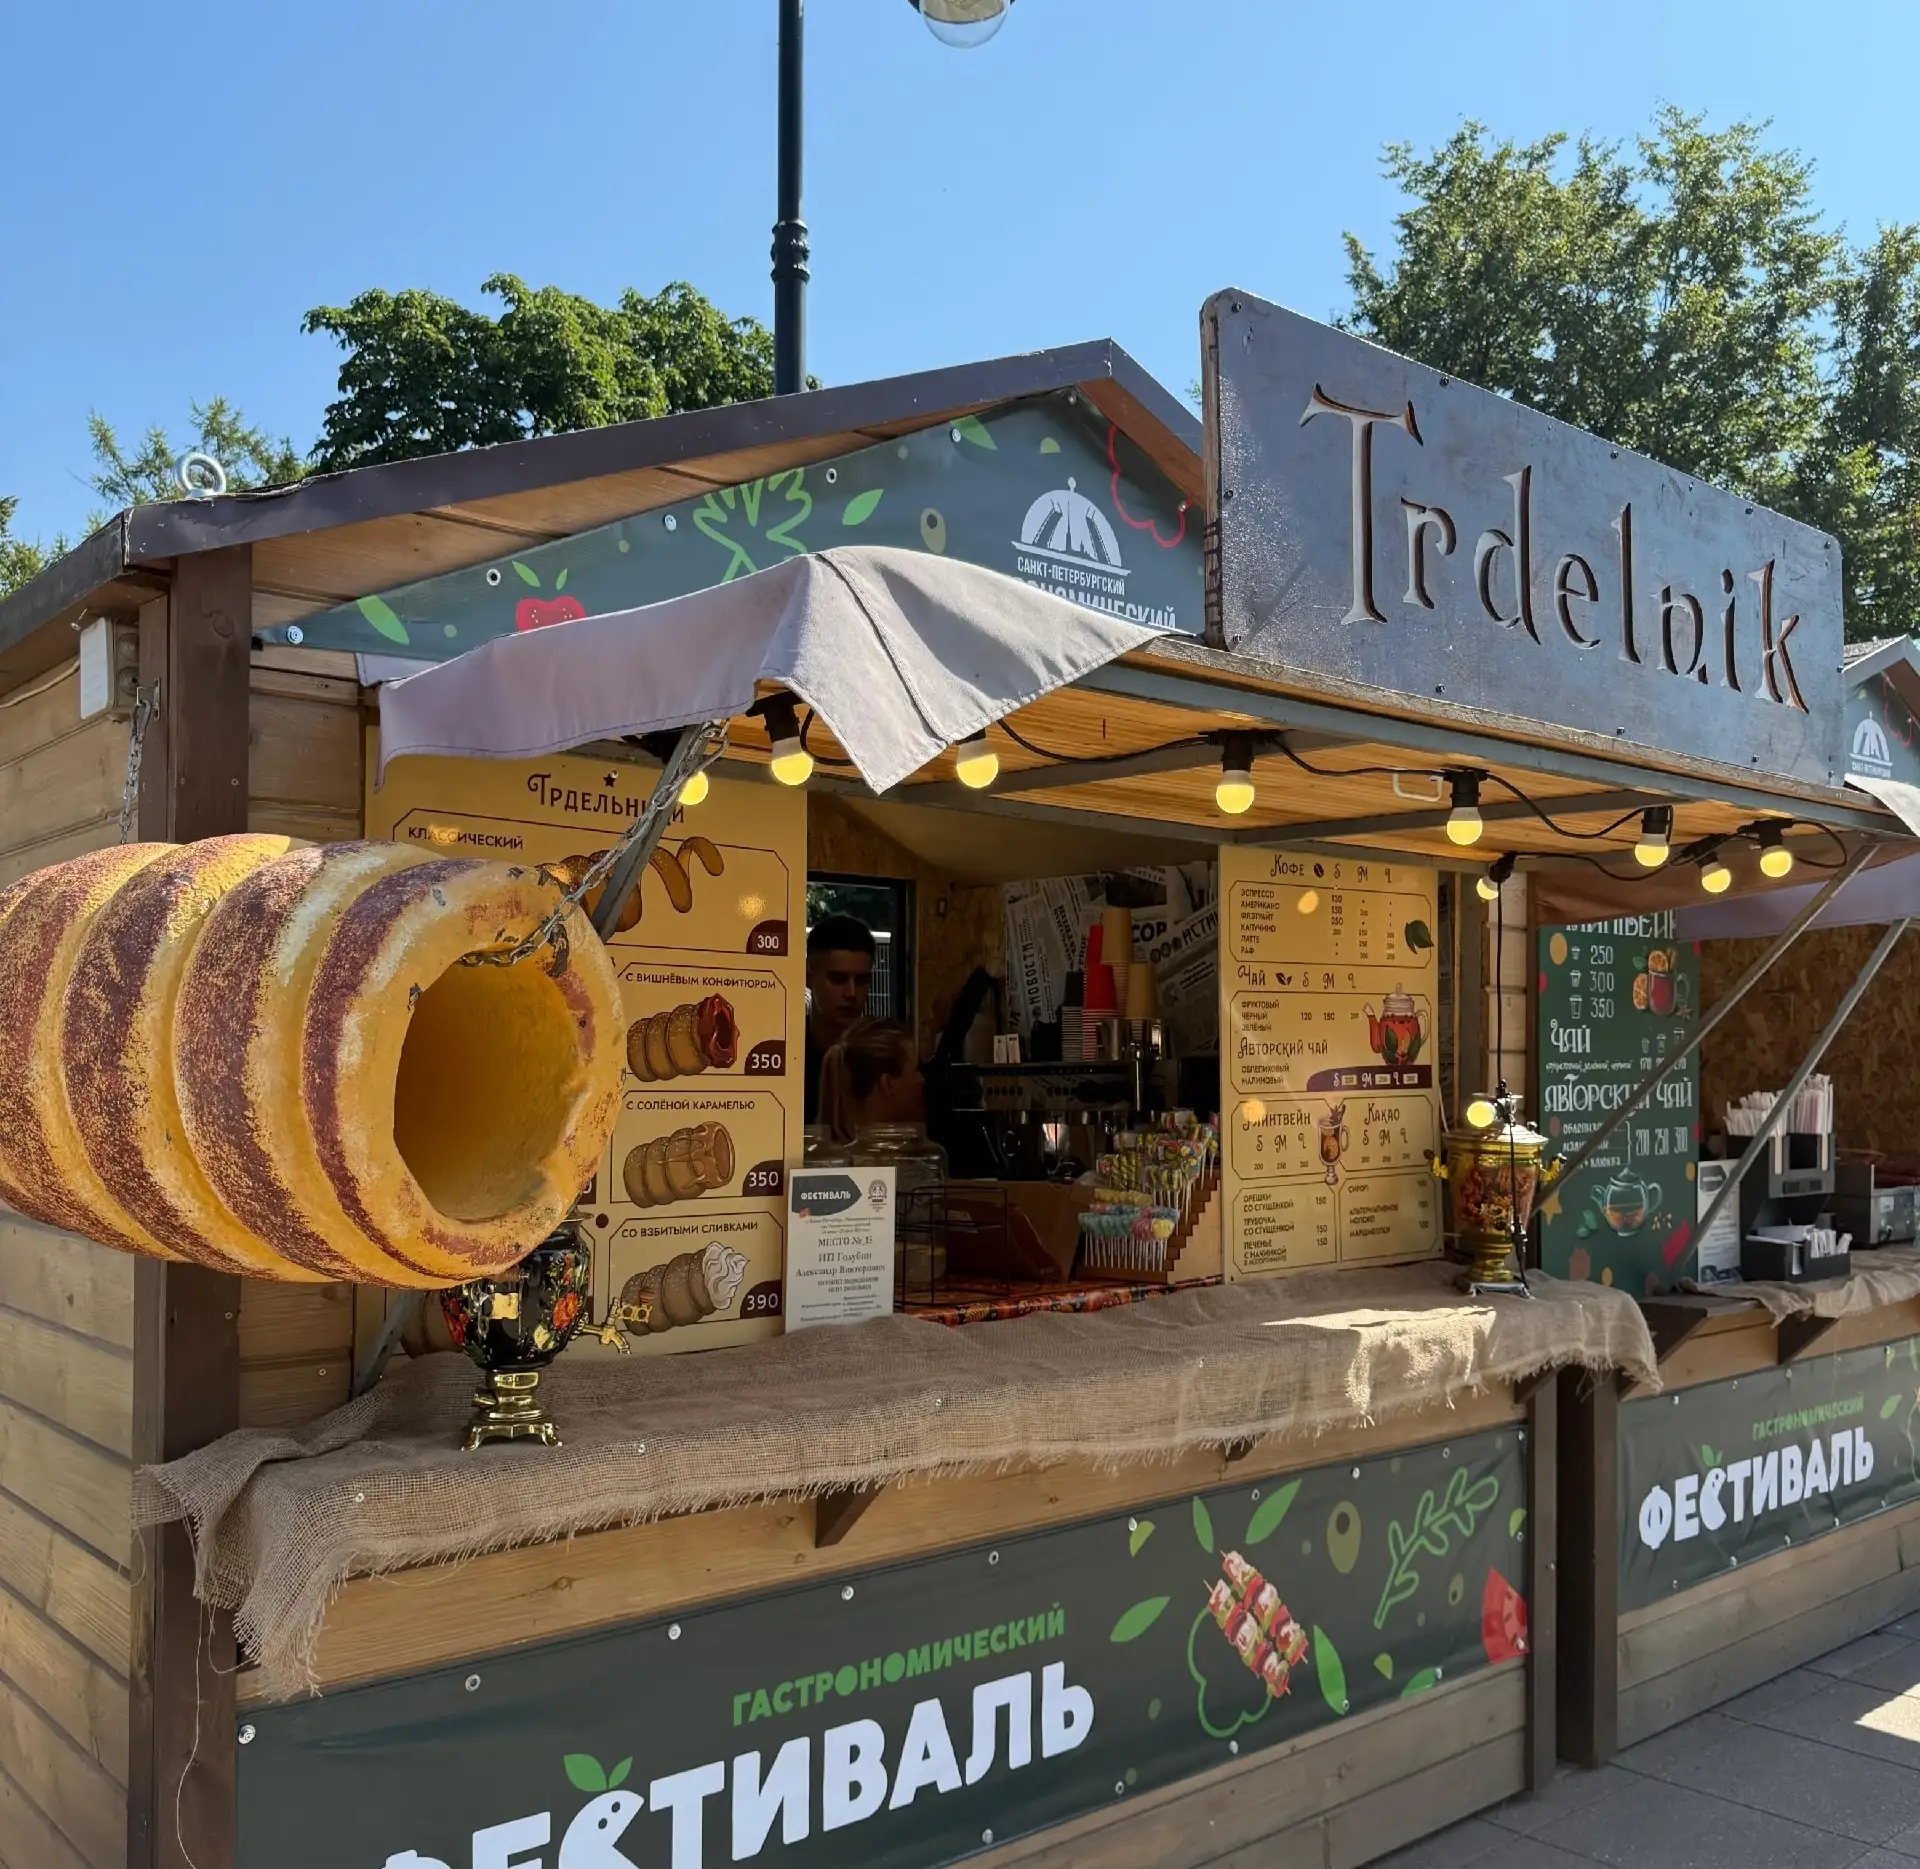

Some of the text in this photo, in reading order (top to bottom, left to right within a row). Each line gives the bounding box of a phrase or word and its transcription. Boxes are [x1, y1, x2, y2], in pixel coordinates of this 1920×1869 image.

[1300, 384, 1809, 713] Trdelnik
[1018, 557, 1125, 596] САНКТ-ПЕТЕРБУРГСКИЙ
[527, 773, 684, 824] ТРДЕЛЬНИ
[408, 826, 523, 850] КЛАССИЧЕСКИЙ
[1240, 889, 1275, 899] ЭСПРЕССО
[1240, 901, 1280, 910] АМЕРИКАНО
[1241, 924, 1276, 933] КАПУЧИНО
[757, 935, 779, 950] 300
[1241, 934, 1260, 944] ЛАТТЕ
[1241, 946, 1255, 955] РАФ
[1590, 946, 1613, 965] 250
[625, 973, 776, 990] С ВИШНЁВЫМ КОНФИТЮРОМ
[1589, 971, 1614, 992] 300
[1241, 999, 1280, 1009] ФРУКТОВЫЙ
[1590, 998, 1614, 1018] 350
[1301, 1012, 1312, 1020] 120
[1323, 1012, 1335, 1020] 150
[752, 1053, 781, 1069] 350
[1241, 1063, 1290, 1074] ОБЛЕПИХОВЫЙ
[1242, 1075, 1284, 1085] МАЛИНОВЫЙ
[626, 1098, 755, 1111] С СОЛЁНОЙ КАРАМЕЛЬЮ
[1635, 1129, 1650, 1156] 200
[1654, 1128, 1669, 1155] 250
[1674, 1127, 1688, 1154] 300
[1254, 1163, 1264, 1171] 200
[748, 1172, 779, 1188] 350
[800, 1190, 851, 1201] ФЕСТИВАЛЬ
[1348, 1184, 1369, 1194] СИРОП
[1243, 1193, 1327, 1205] ОРЕШКИ 150
[1244, 1204, 1254, 1212] СО
[1243, 1216, 1276, 1226] ТРУБОЧКА
[1350, 1215, 1375, 1224] МОЛОКО
[621, 1221, 758, 1239] СО ВЗБИТЫМИ СЛИВКАМИ
[1243, 1227, 1254, 1236] СО
[1316, 1224, 1328, 1233] 150
[818, 1237, 850, 1247] МЕСТО
[1244, 1237, 1328, 1250] ПЕЧЕНЬЕ 150
[818, 1252, 835, 1262] ИП
[1244, 1245, 1287, 1259] С НАЧИНКОЙ
[795, 1264, 886, 1277] Александр Викторович
[747, 1293, 779, 1310] 390
[1753, 1391, 1864, 1441] ГАСТРОНОМИЧЕСКИЙ
[1638, 1426, 1874, 1550] ФЕСТИВАЛЬ
[732, 1603, 1066, 1726] ГАСТРОНОМИЧЕСКИЙ
[383, 1661, 1095, 1869] СТИВАЛЬ
